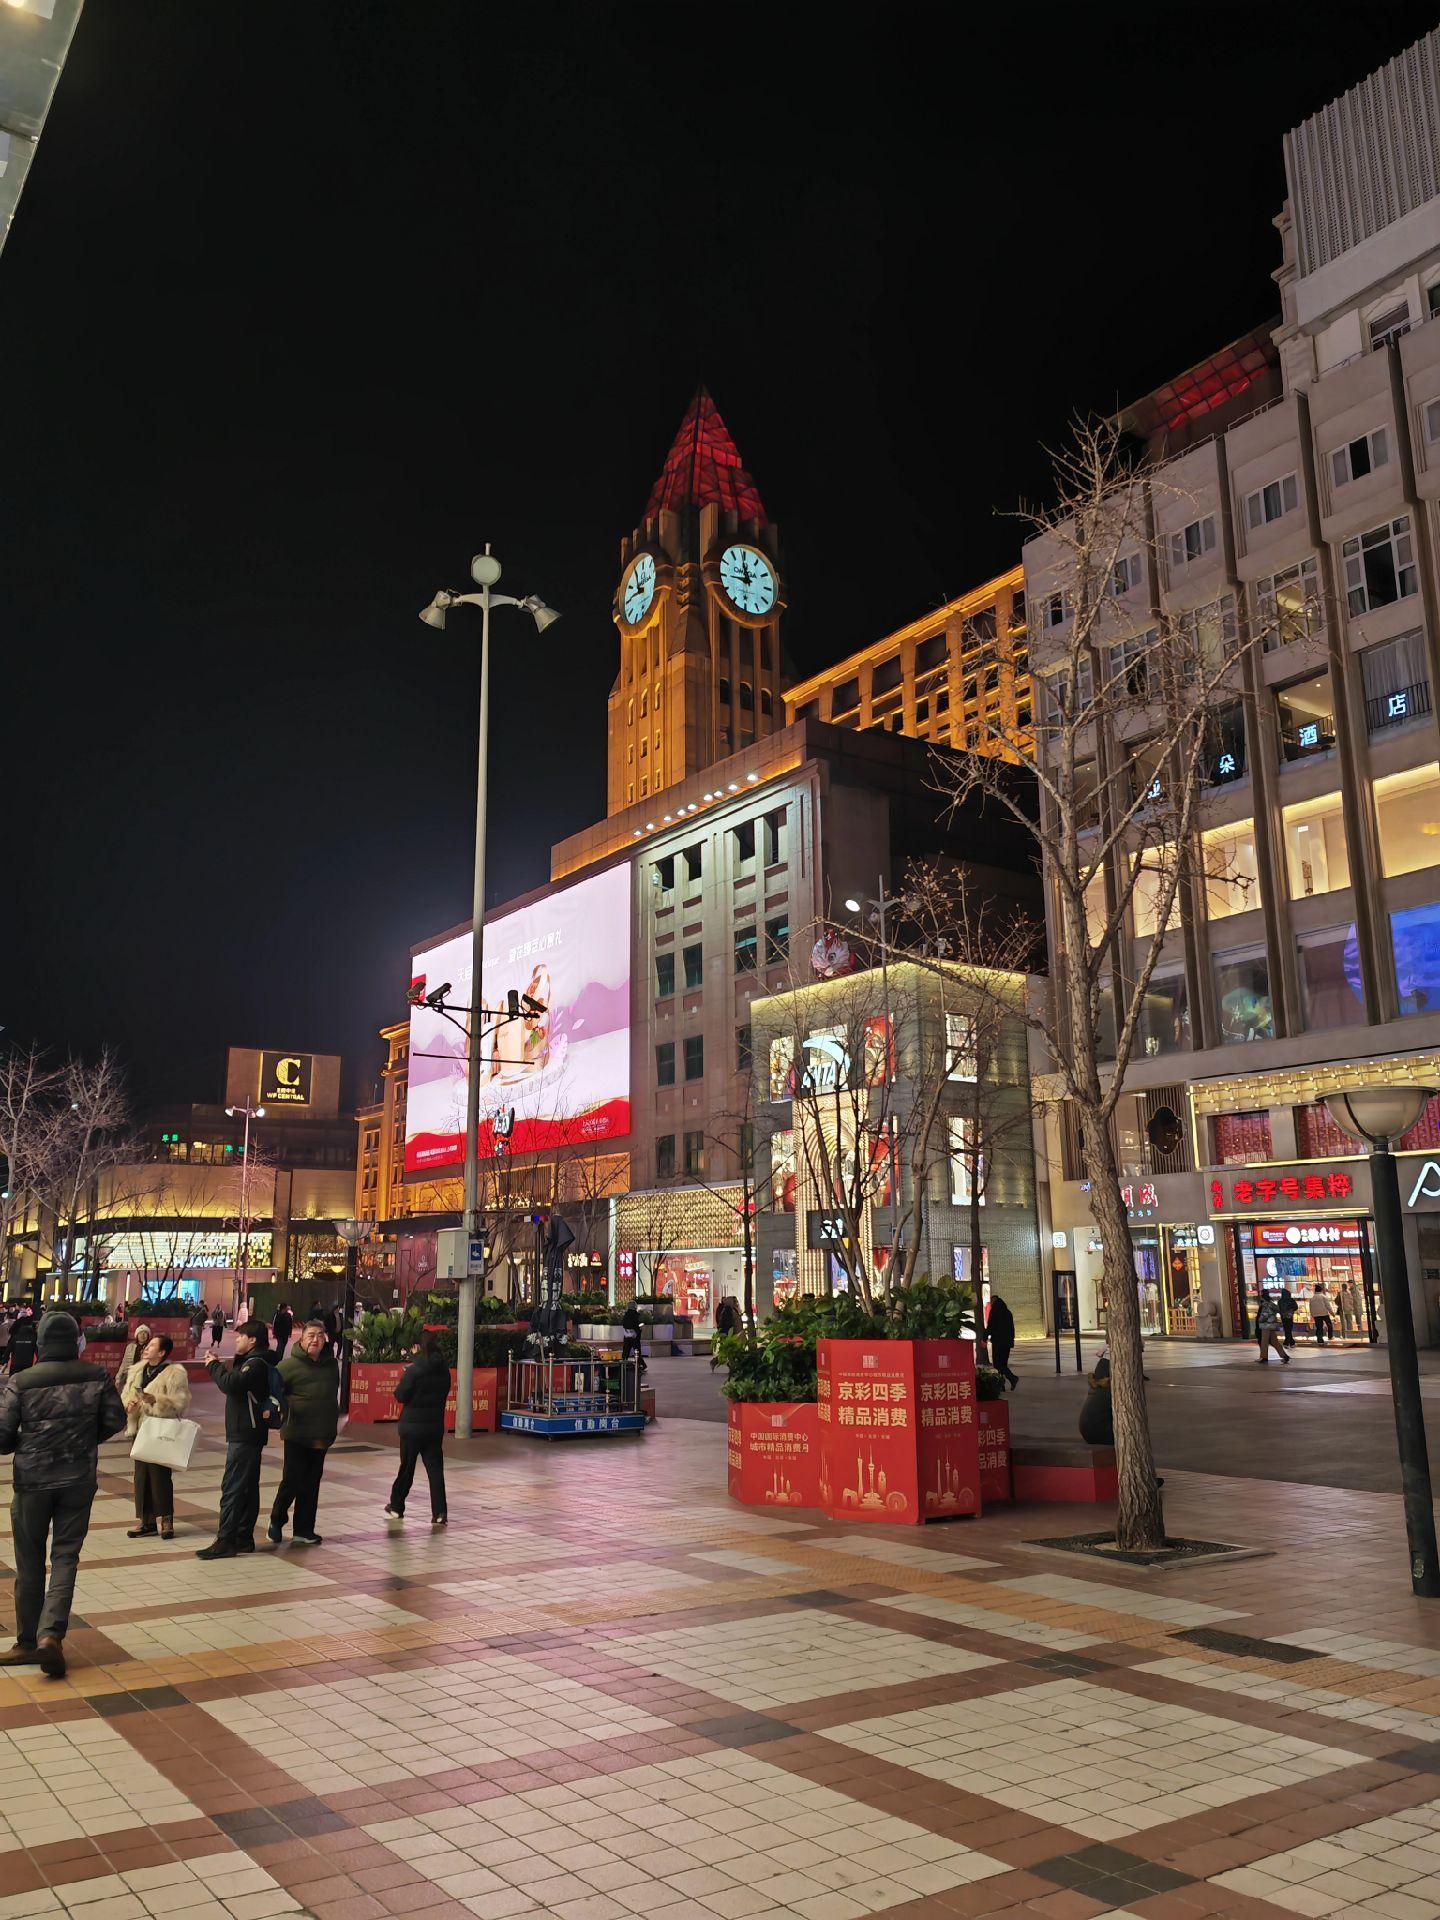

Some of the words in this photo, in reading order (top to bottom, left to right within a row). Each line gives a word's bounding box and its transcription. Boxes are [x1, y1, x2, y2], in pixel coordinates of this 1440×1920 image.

[1233, 1172, 1353, 1204] 老字号集粹
[173, 1255, 231, 1268] HUAWEI
[838, 1381, 907, 1402] 京彩四季
[921, 1381, 971, 1402] 京彩四季
[838, 1406, 908, 1428] 精品消费
[921, 1405, 973, 1427] 精品消费
